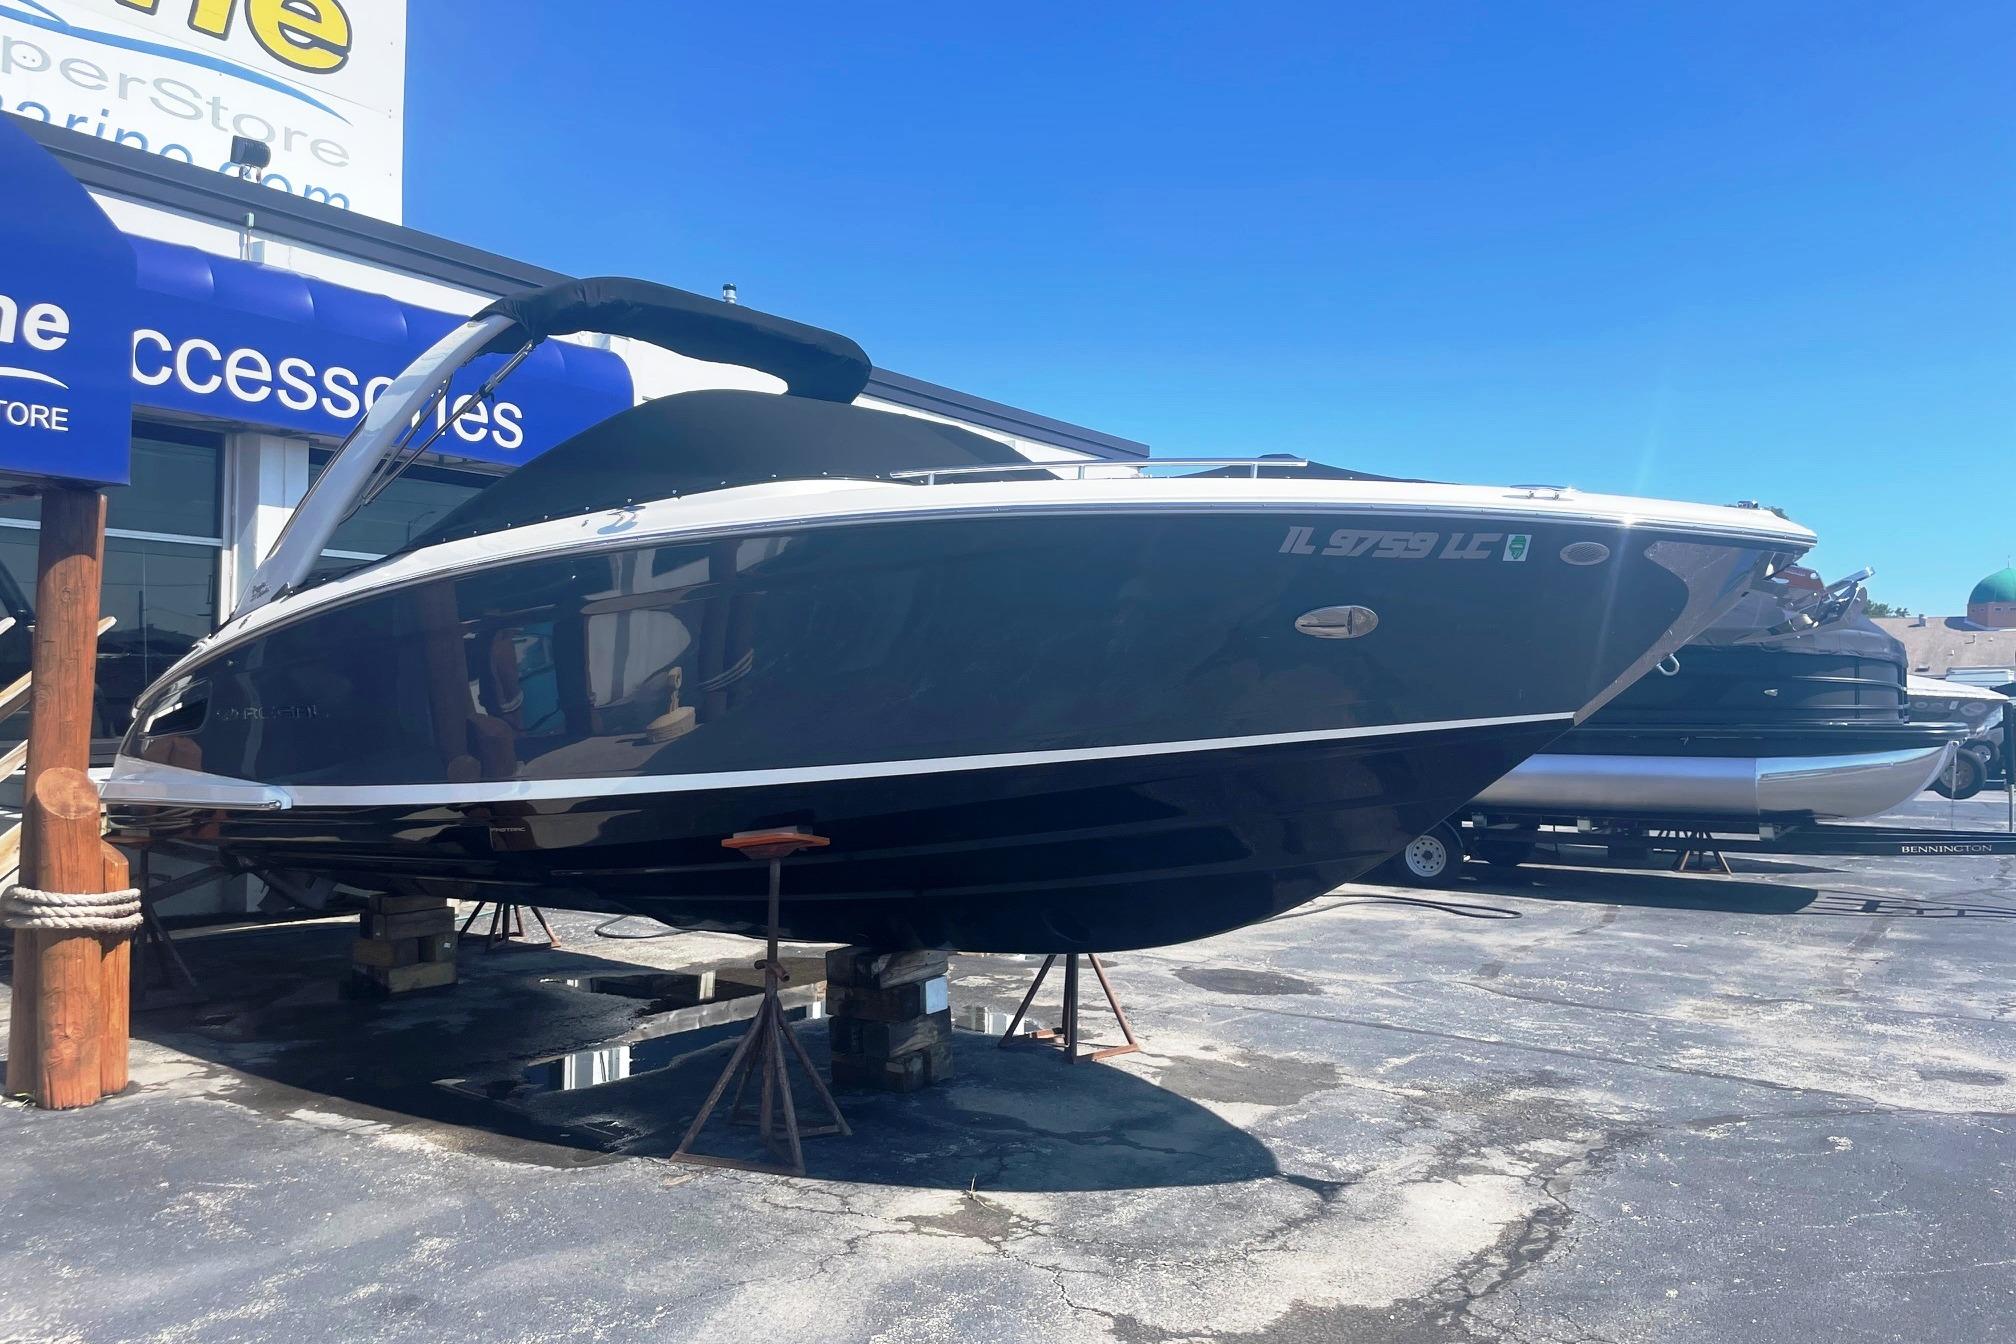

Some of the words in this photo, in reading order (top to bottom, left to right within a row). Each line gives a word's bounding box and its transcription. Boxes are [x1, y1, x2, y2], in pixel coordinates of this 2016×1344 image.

[132, 329, 524, 449] ccessoies
[1278, 525, 1316, 555] IL
[1321, 528, 1440, 559] 9759
[1438, 532, 1504, 560] LC
[1901, 844, 1993, 853] BENNINGTON
